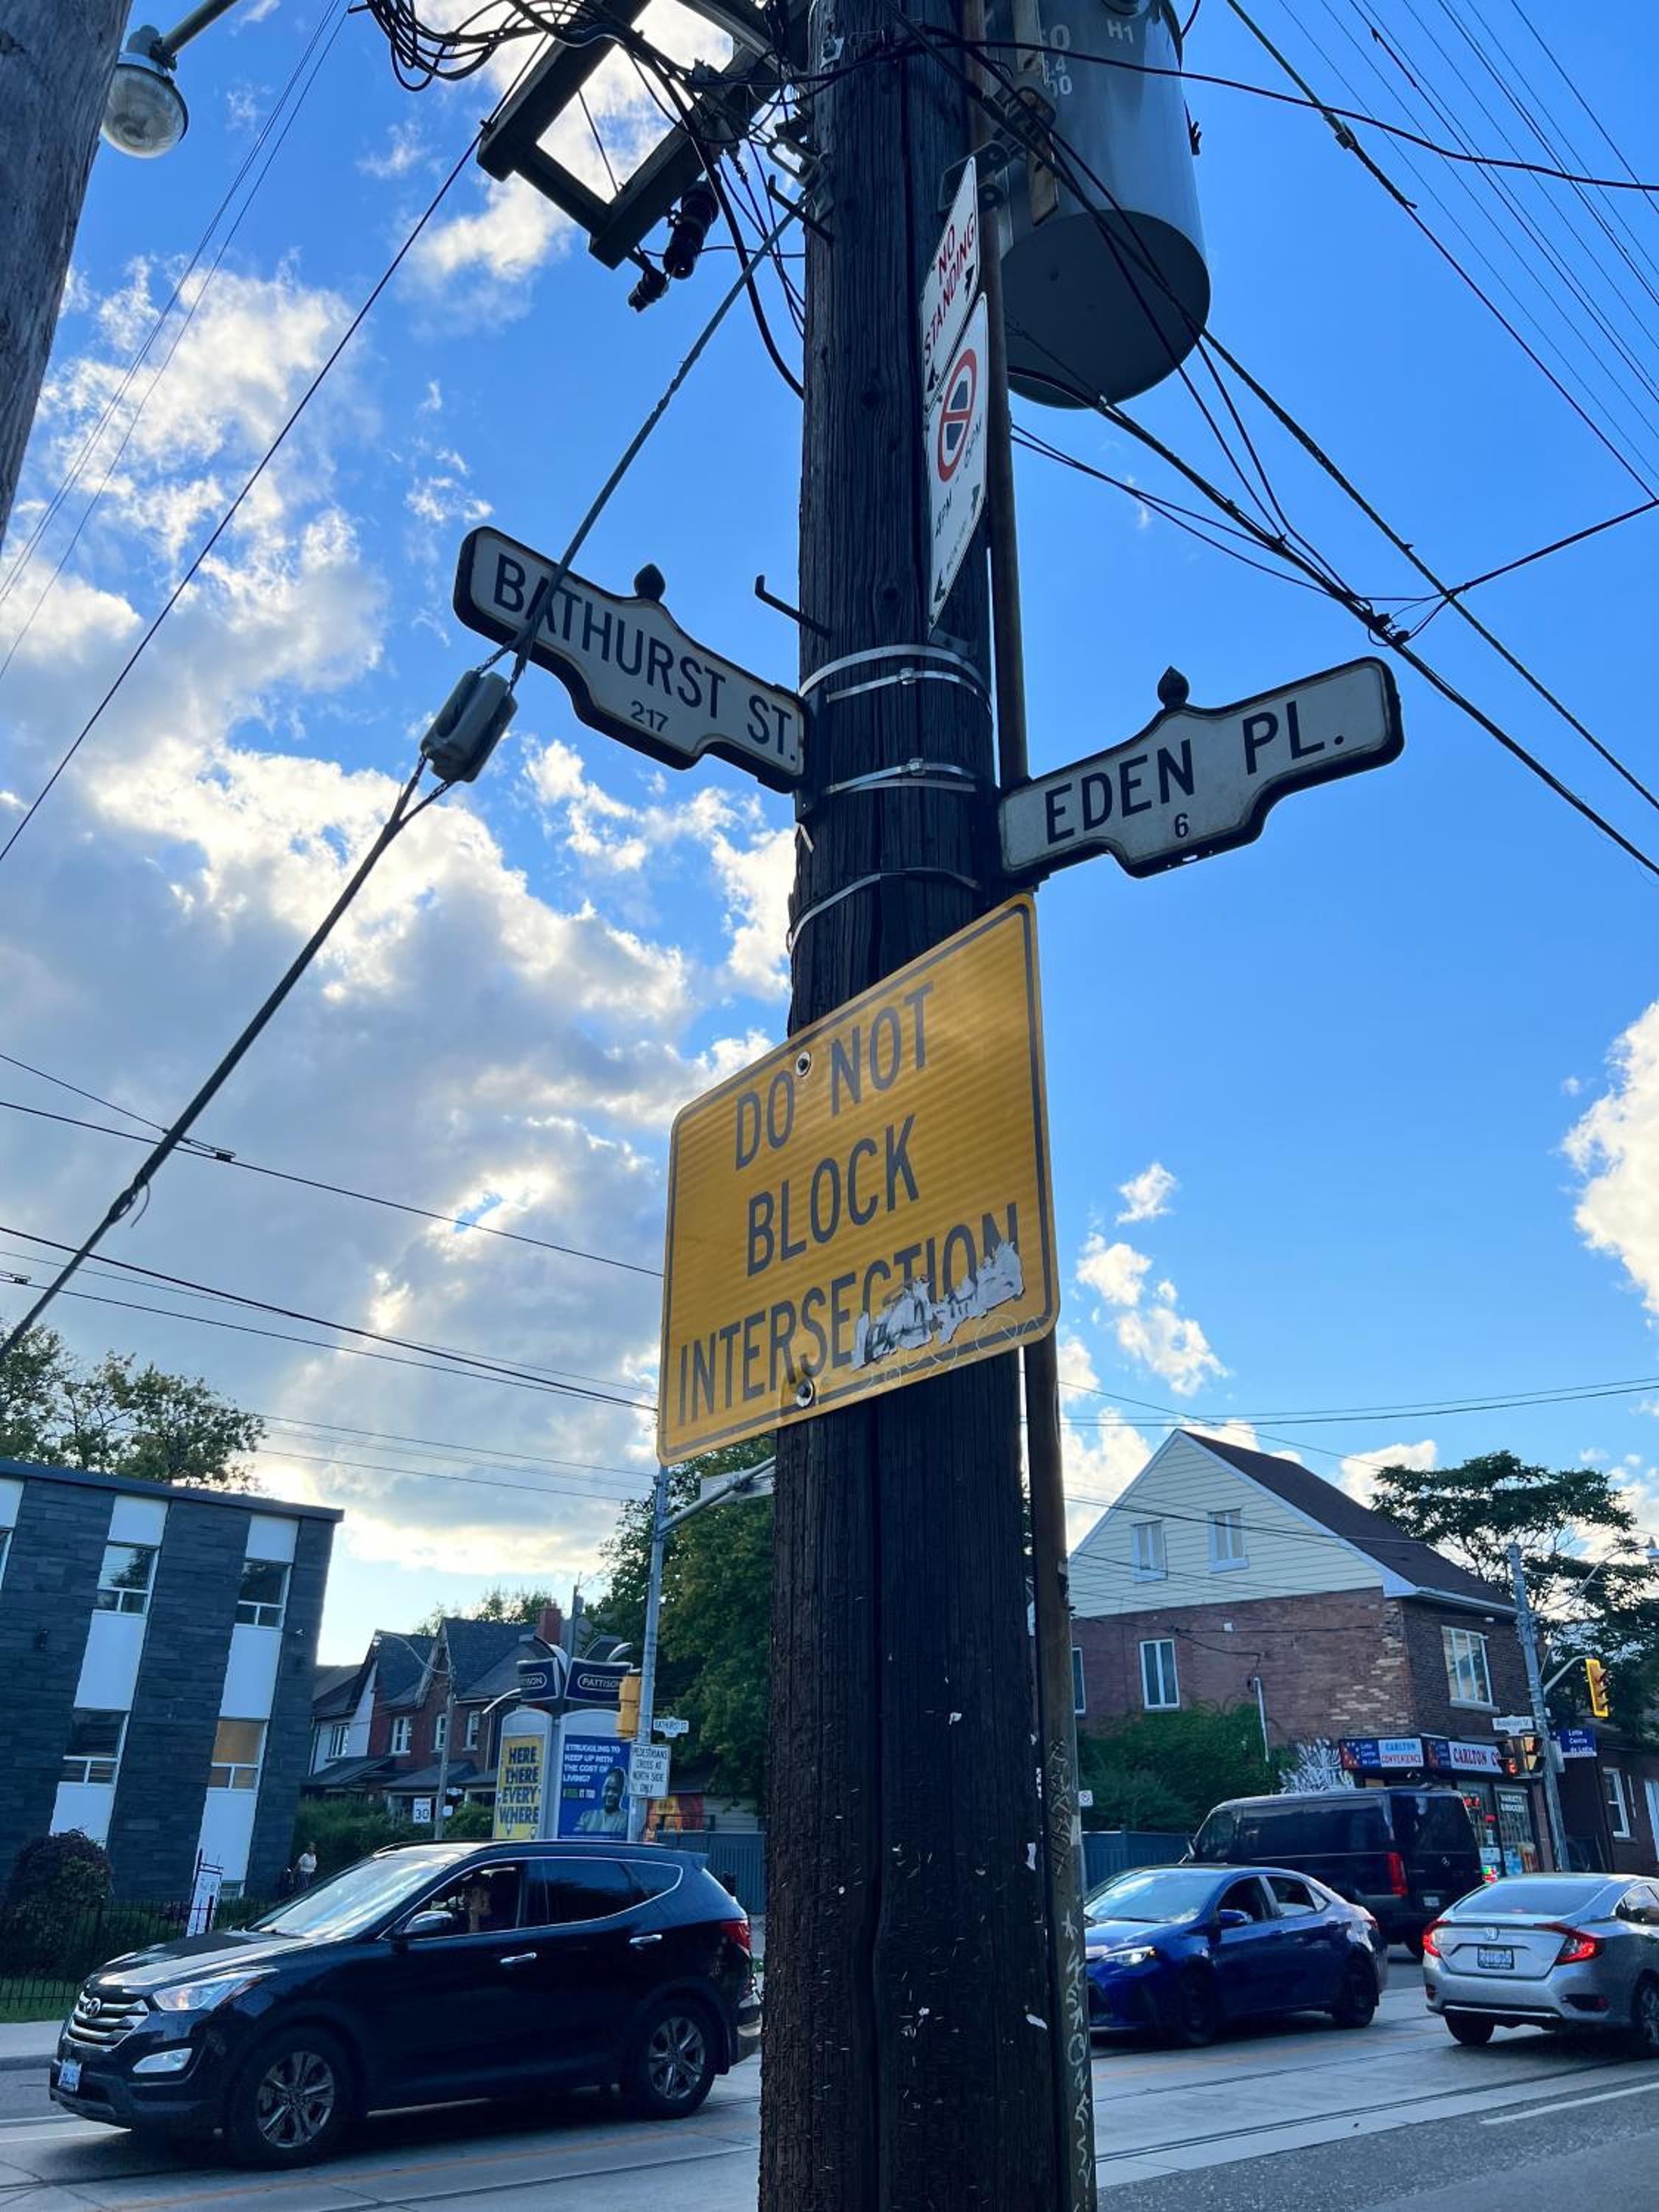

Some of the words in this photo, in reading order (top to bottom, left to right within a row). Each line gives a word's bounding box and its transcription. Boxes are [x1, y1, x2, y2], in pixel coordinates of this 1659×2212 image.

[1106, 19, 1133, 44] H1
[937, 223, 956, 279] NO
[924, 212, 975, 366] STANDING
[493, 554, 726, 720] BATHURST
[747, 695, 796, 761] ST.
[630, 700, 669, 733] 217
[1045, 740, 1195, 844] EDEN
[1242, 701, 1344, 775] PL.
[1174, 813, 1189, 838] 6
[736, 1068, 795, 1170] DO
[831, 982, 933, 1116] NOT
[747, 1115, 919, 1277] BLOCK
[582, 1677, 619, 1688] PATTISO
[566, 1744, 610, 1753] STRUGGLING
[611, 1745, 621, 1753] TO
[633, 1746, 667, 1760] PEDESTRIANS
[1385, 1742, 1416, 1752] CARLTON
[1382, 1754, 1422, 1764] CONVENIENCE
[1453, 1747, 1487, 1766] CARLTON
[565, 1764, 579, 1772] THE
[651, 1773, 664, 1782] SIDE
[640, 1783, 654, 1793] ONLY
[415, 1809, 430, 1820] 30
[499, 1806, 540, 1824] WHERE
